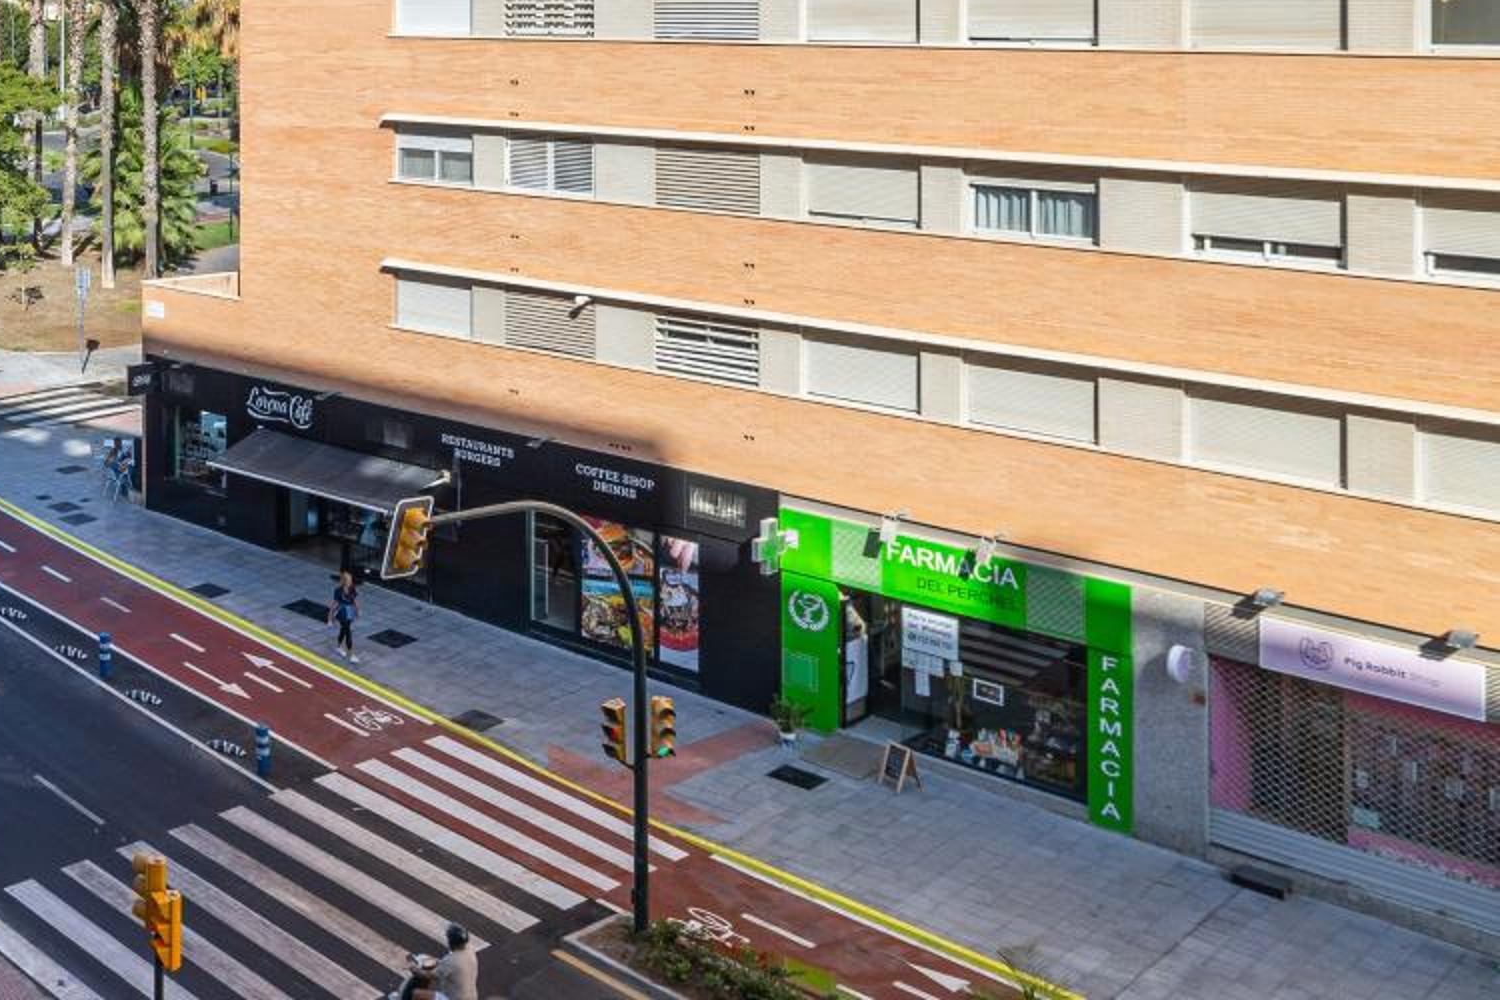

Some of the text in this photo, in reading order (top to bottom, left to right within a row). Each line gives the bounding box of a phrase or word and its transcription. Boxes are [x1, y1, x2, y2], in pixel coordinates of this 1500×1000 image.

[575, 463, 655, 491] COFFEE SHOP
[593, 480, 637, 499] DRINKS
[886, 539, 1019, 590] FARMACIA
[916, 576, 947, 594] DEL
[1365, 662, 1407, 679] Rabbit
[1100, 655, 1122, 822] FARMACIA
